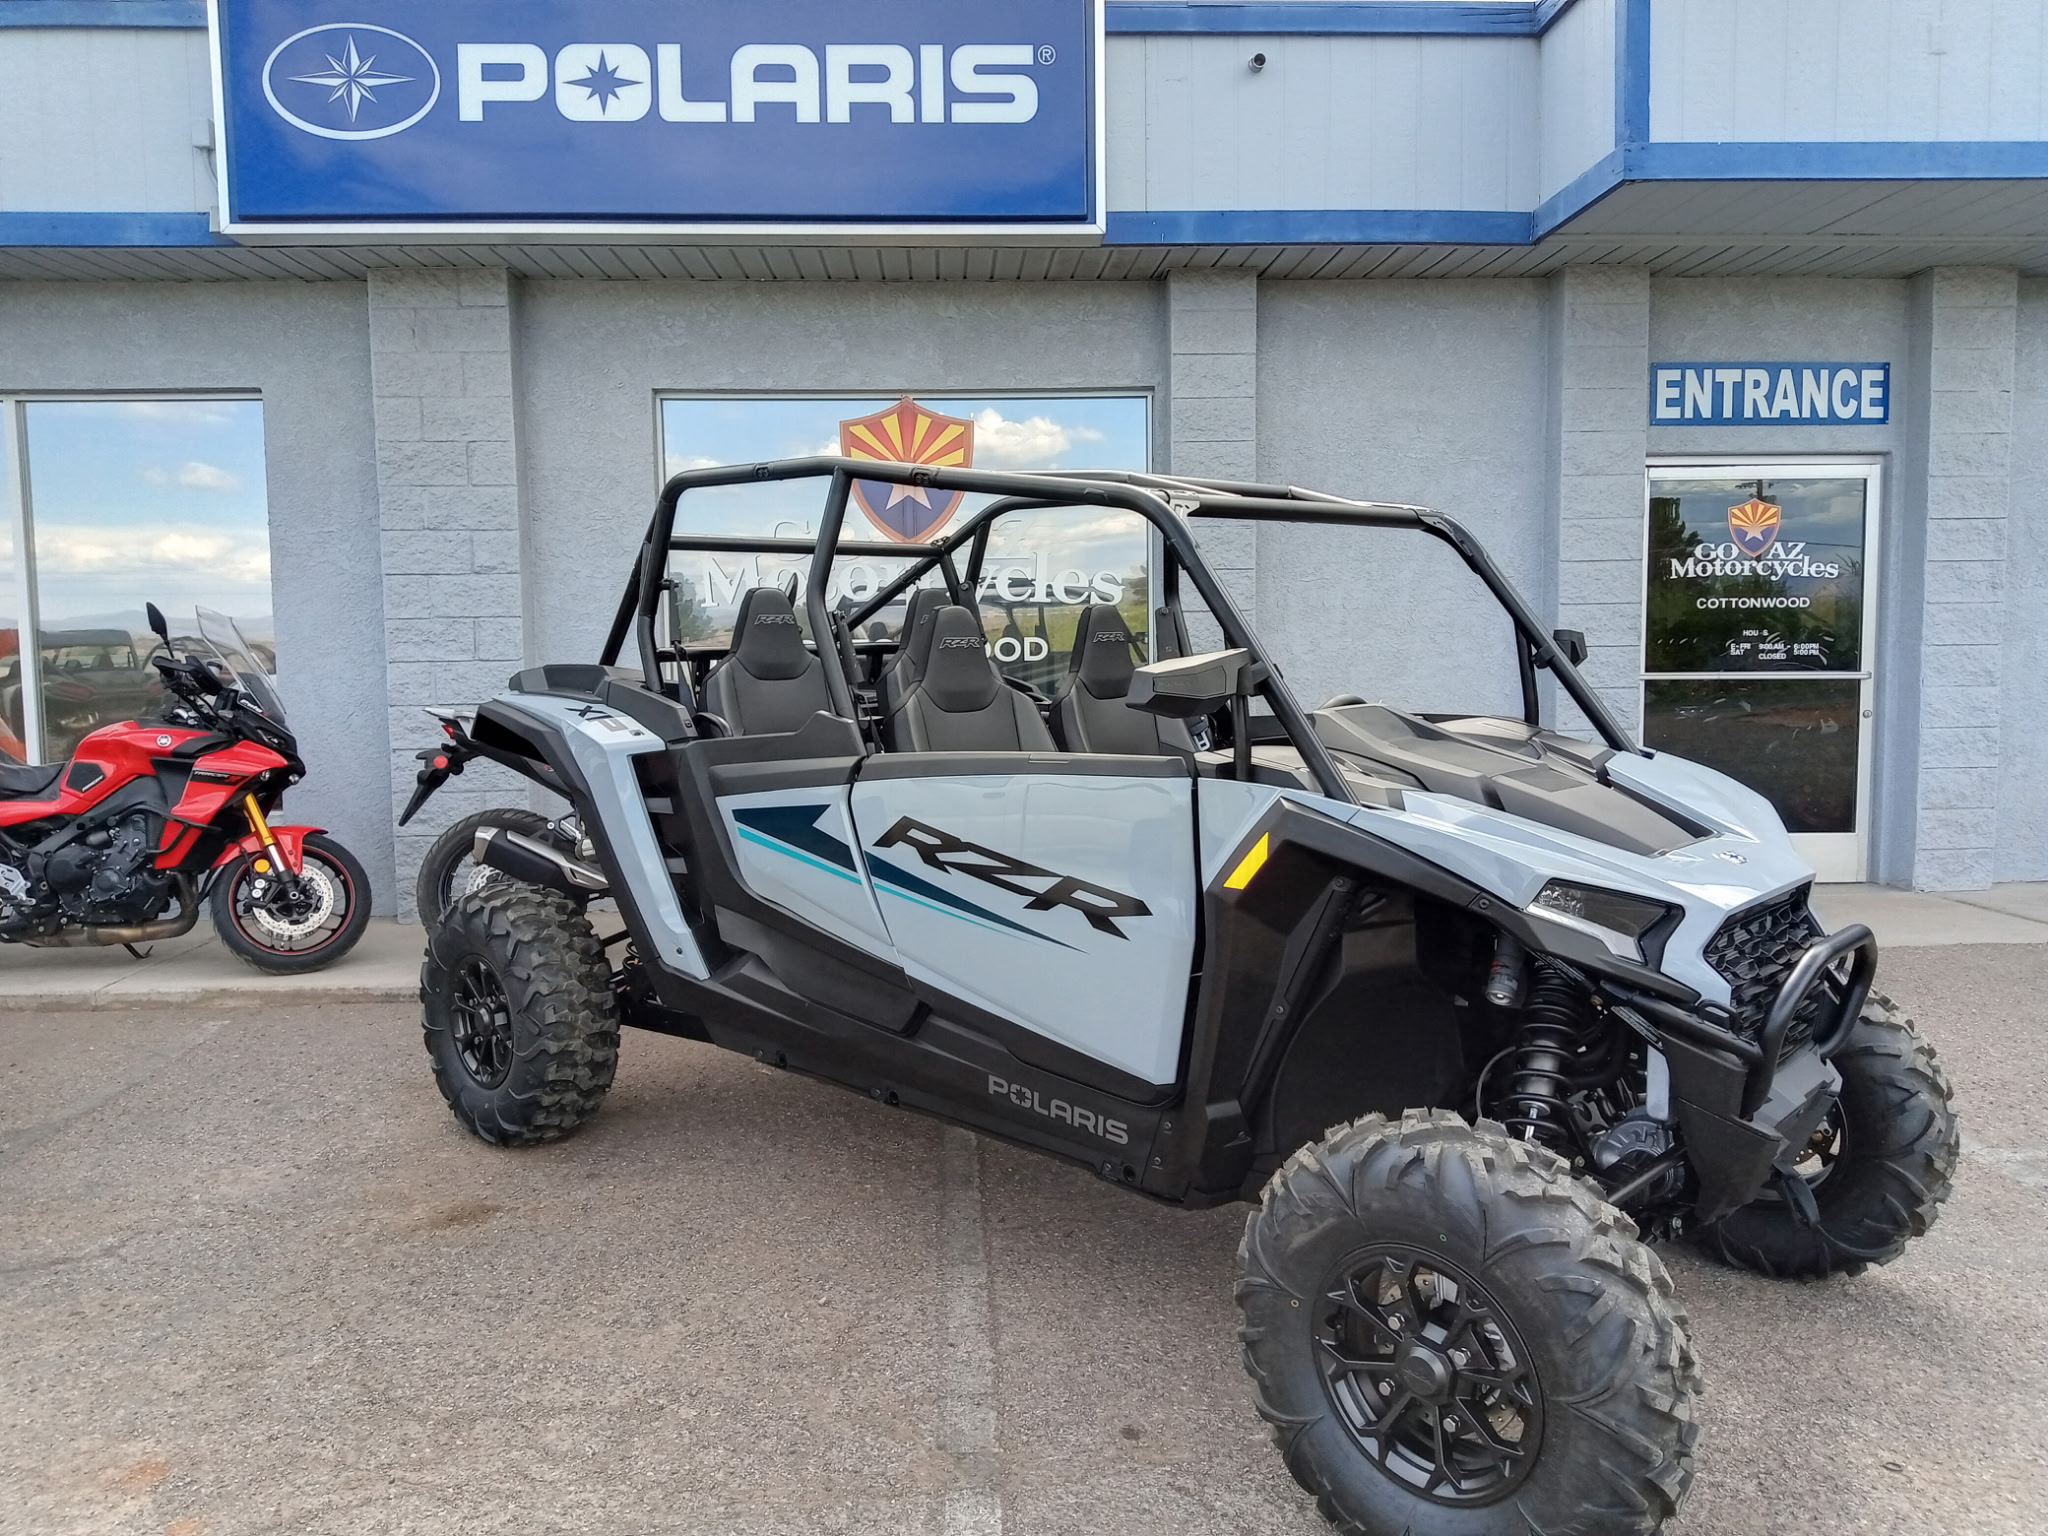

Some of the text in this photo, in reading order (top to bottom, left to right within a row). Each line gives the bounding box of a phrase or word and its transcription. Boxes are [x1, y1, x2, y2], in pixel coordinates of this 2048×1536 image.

[1656, 368, 1885, 419] ENTRANCE
[1694, 541, 1806, 561] GO AZ
[1669, 555, 1840, 581] Motorcycles
[1696, 597, 1810, 609] COTTONWOOD
[939, 636, 981, 649] RZR
[1743, 629, 1769, 637] HOUS
[872, 815, 1153, 941] RZR
[988, 1074, 1129, 1145] POLARIS
